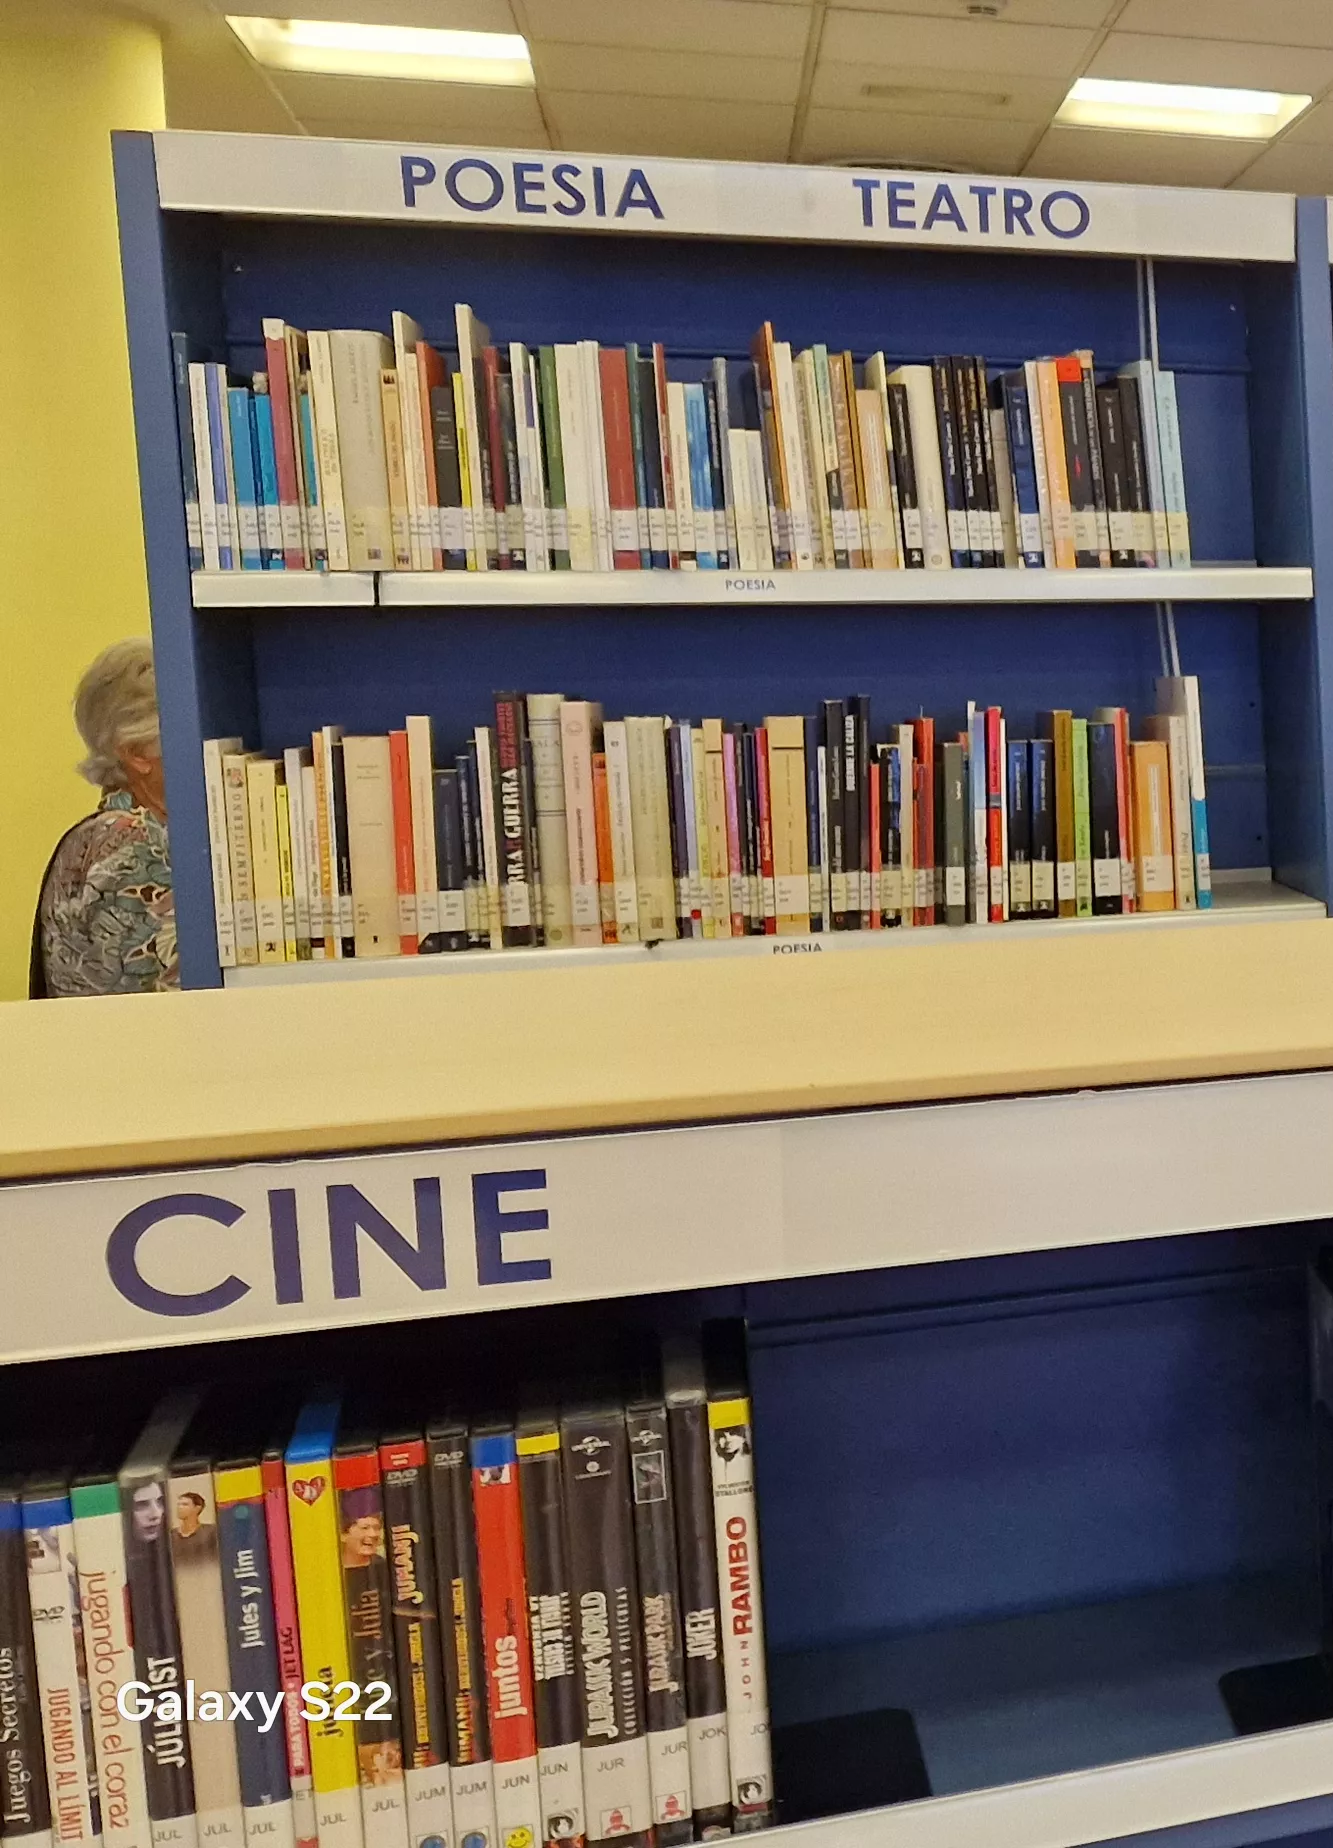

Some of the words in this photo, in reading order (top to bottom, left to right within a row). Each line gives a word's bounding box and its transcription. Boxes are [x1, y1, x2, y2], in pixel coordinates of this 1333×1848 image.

[401, 155, 666, 220] POESIA
[852, 178, 1090, 239] TEATRO
[725, 578, 776, 591] POESIA
[504, 768, 519, 840] GUERRA
[773, 942, 823, 954] POESIA
[105, 1169, 552, 1317] CINE
[235, 1549, 260, 1579] Jim
[390, 1523, 424, 1605] JUMANJI
[726, 1516, 754, 1635] RAMBO
[240, 1585, 260, 1599] y
[351, 1588, 381, 1640] Julia
[80, 1569, 125, 1675] jugando
[240, 1600, 265, 1651] Jules
[580, 1591, 610, 1649] WORLD
[686, 1607, 716, 1660] JOKER
[0, 1647, 20, 1744] Secretos
[495, 1635, 527, 1719] juntos
[582, 1649, 619, 1738] JURASSIC
[739, 1639, 752, 1699] JOHN
[47, 1687, 74, 1765] JUGANDO
[100, 1734, 134, 1755] el
[699, 1726, 726, 1741] JOK
[3, 1748, 32, 1824] Juegos
[54, 1769, 74, 1790] AL
[500, 1774, 531, 1790] JUN
[597, 1757, 626, 1772] JUR
[56, 1792, 83, 1842] LÍMIT
[415, 1786, 446, 1801] JUM
